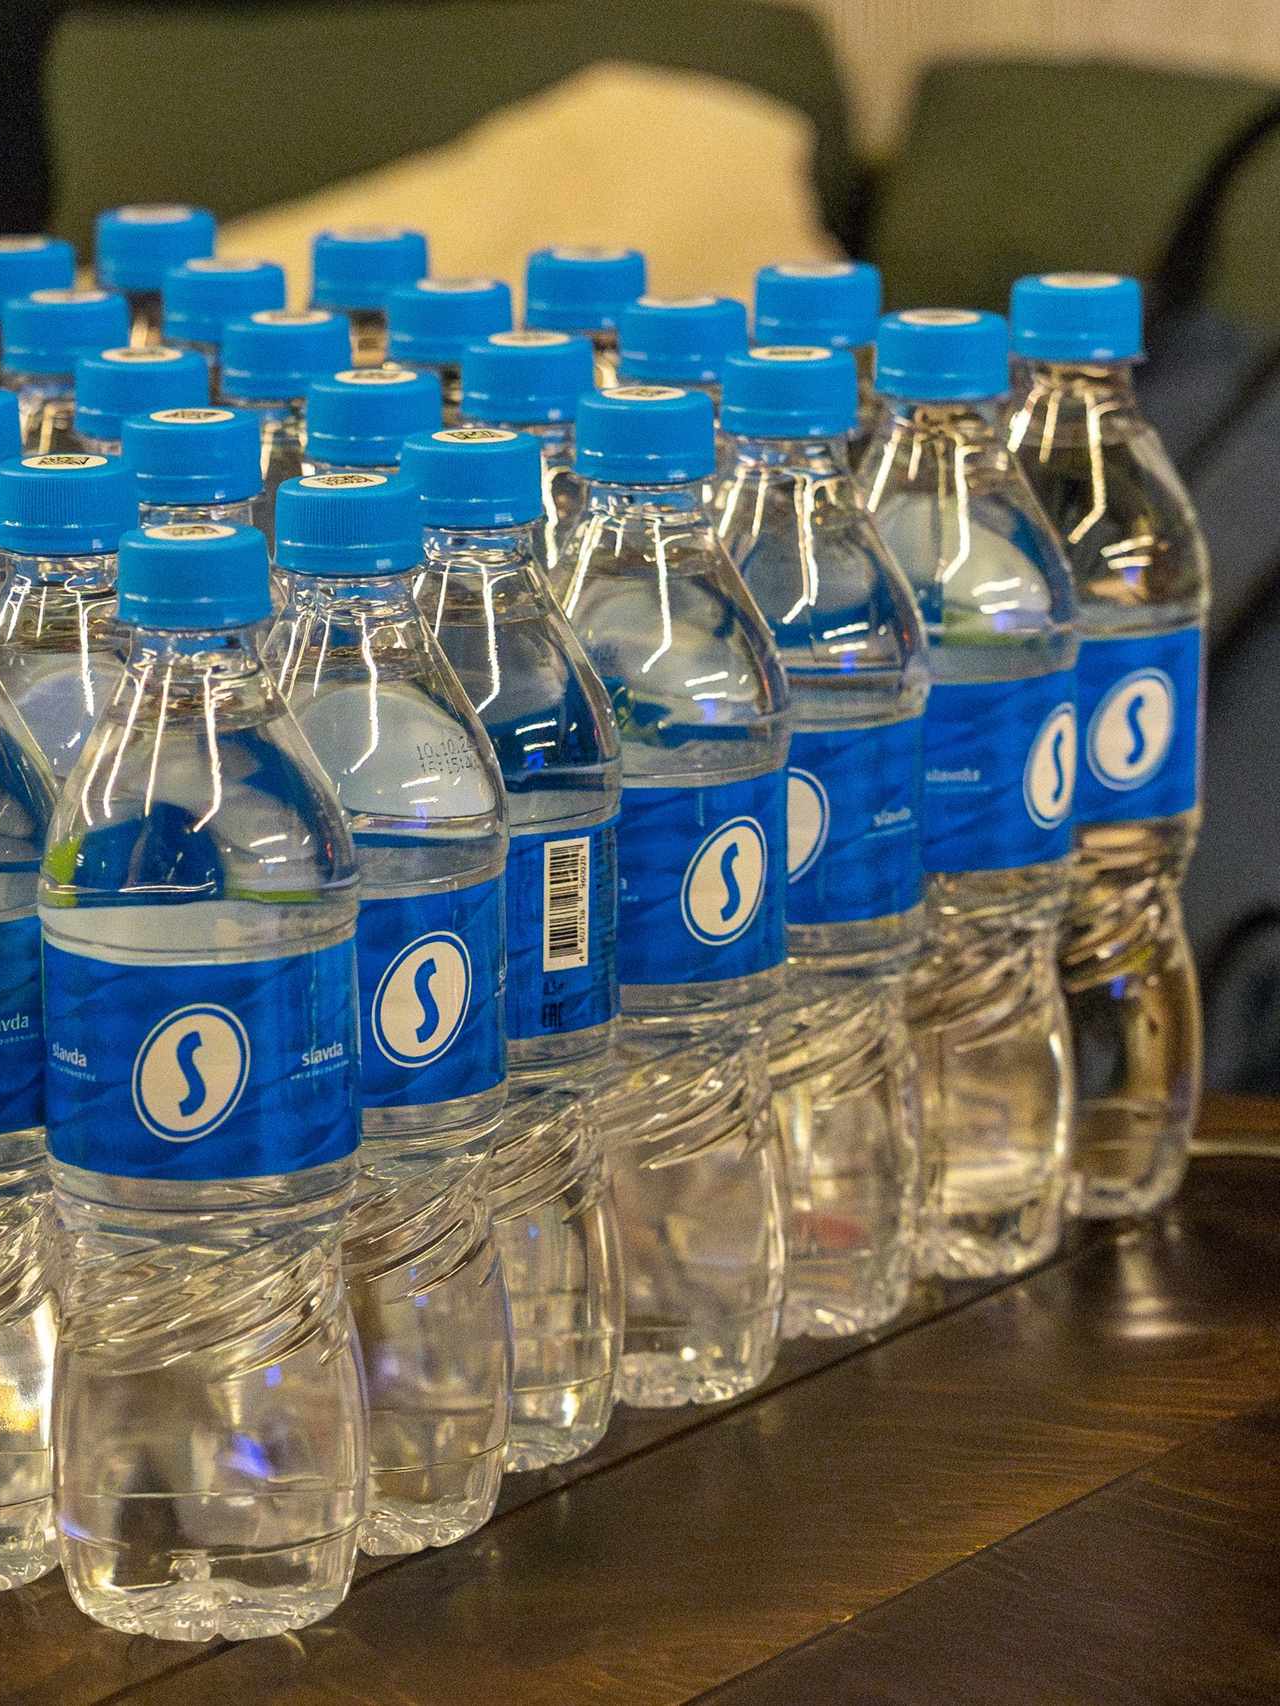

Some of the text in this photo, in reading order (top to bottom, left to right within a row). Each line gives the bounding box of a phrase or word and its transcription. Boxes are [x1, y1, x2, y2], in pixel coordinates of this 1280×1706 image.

[416, 735, 470, 761] 10.10.2
[52, 1042, 87, 1068] slavda
[302, 1040, 344, 1067] slavda
